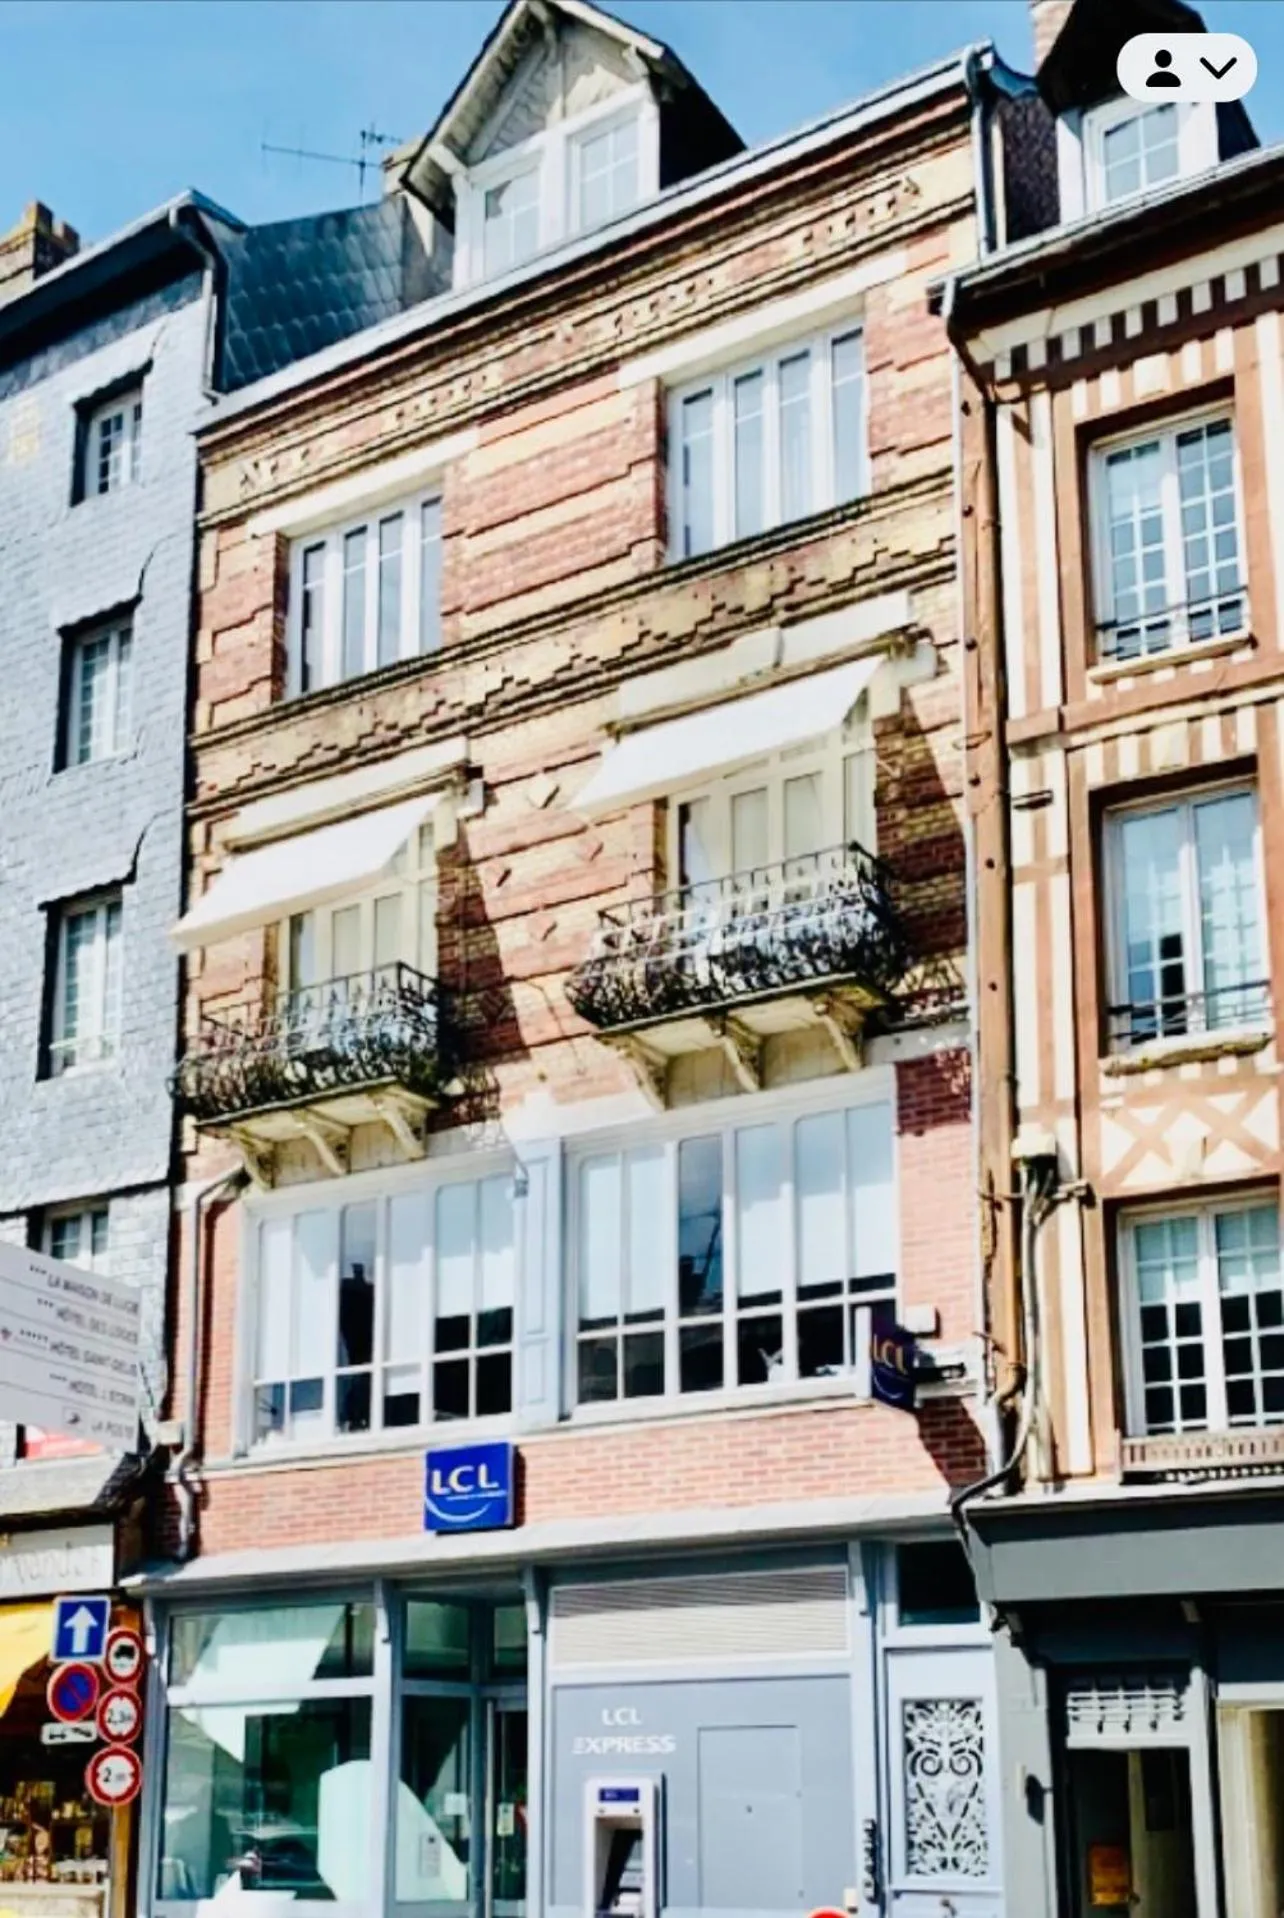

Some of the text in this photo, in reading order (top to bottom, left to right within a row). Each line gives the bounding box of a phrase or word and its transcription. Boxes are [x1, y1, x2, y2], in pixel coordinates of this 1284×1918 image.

[872, 1333, 909, 1376] LCL
[432, 1463, 499, 1495] LCL
[602, 1707, 642, 1726] LCL
[571, 1734, 676, 1755] EXPRESS
